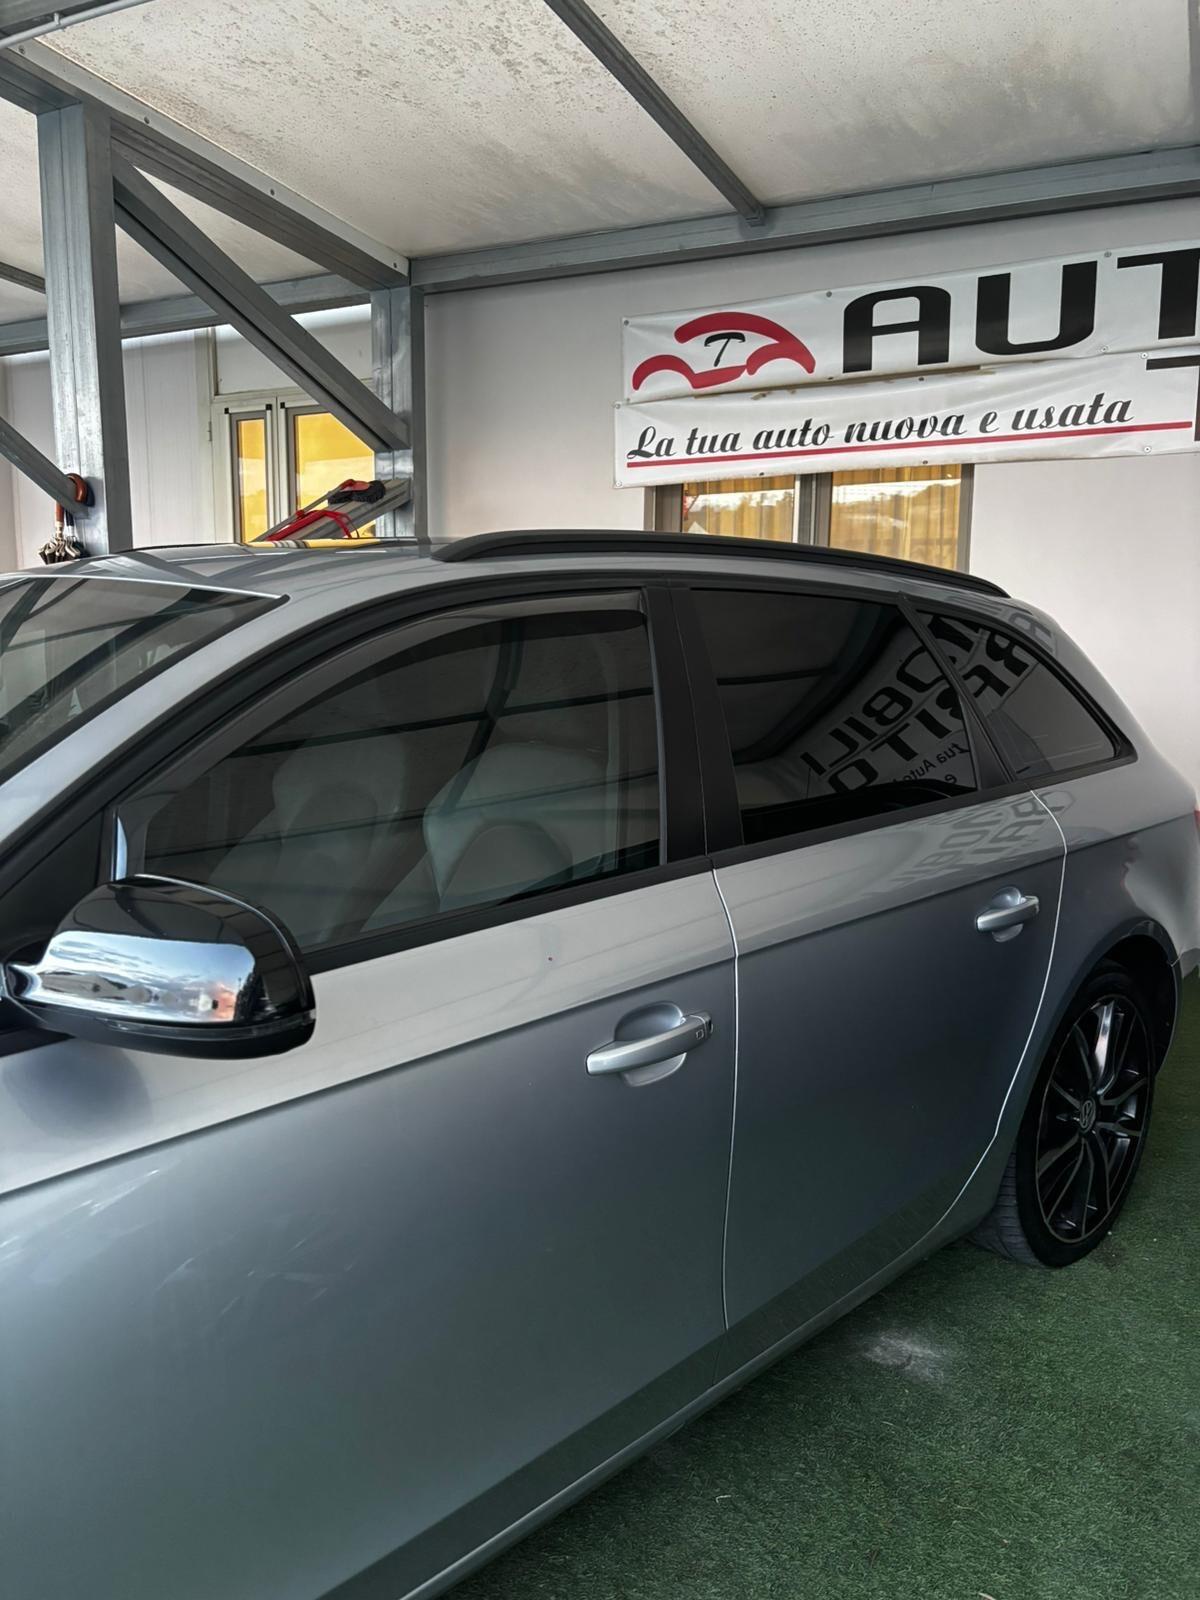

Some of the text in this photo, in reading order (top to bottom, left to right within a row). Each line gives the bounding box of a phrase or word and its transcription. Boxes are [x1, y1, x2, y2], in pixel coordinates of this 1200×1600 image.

[843, 247, 1200, 374] AUT
[626, 392, 1134, 459] La tua auto nuova e usata
